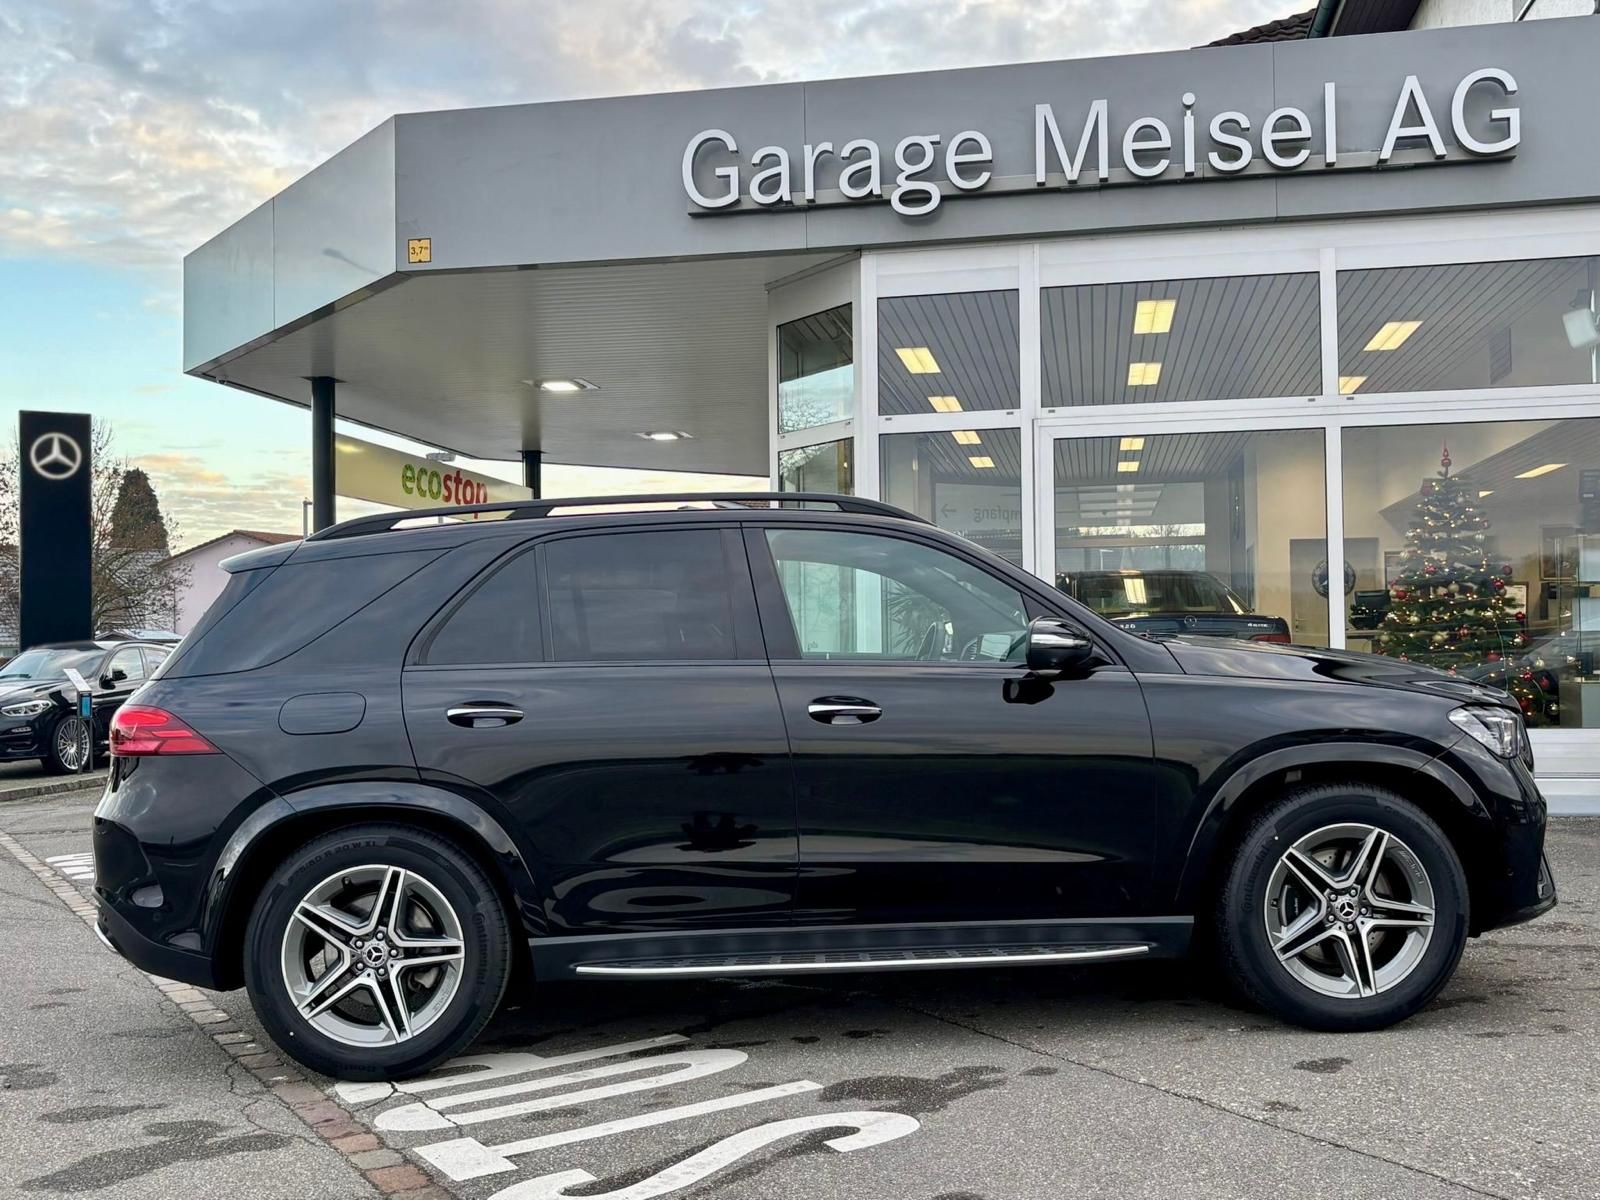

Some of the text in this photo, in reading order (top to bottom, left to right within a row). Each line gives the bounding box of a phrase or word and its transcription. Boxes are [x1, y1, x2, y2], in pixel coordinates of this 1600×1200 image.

[682, 68, 1521, 217] Garage Meisel AG
[401, 463, 488, 519] ecostop
[335, 1033, 921, 1200] STOP
